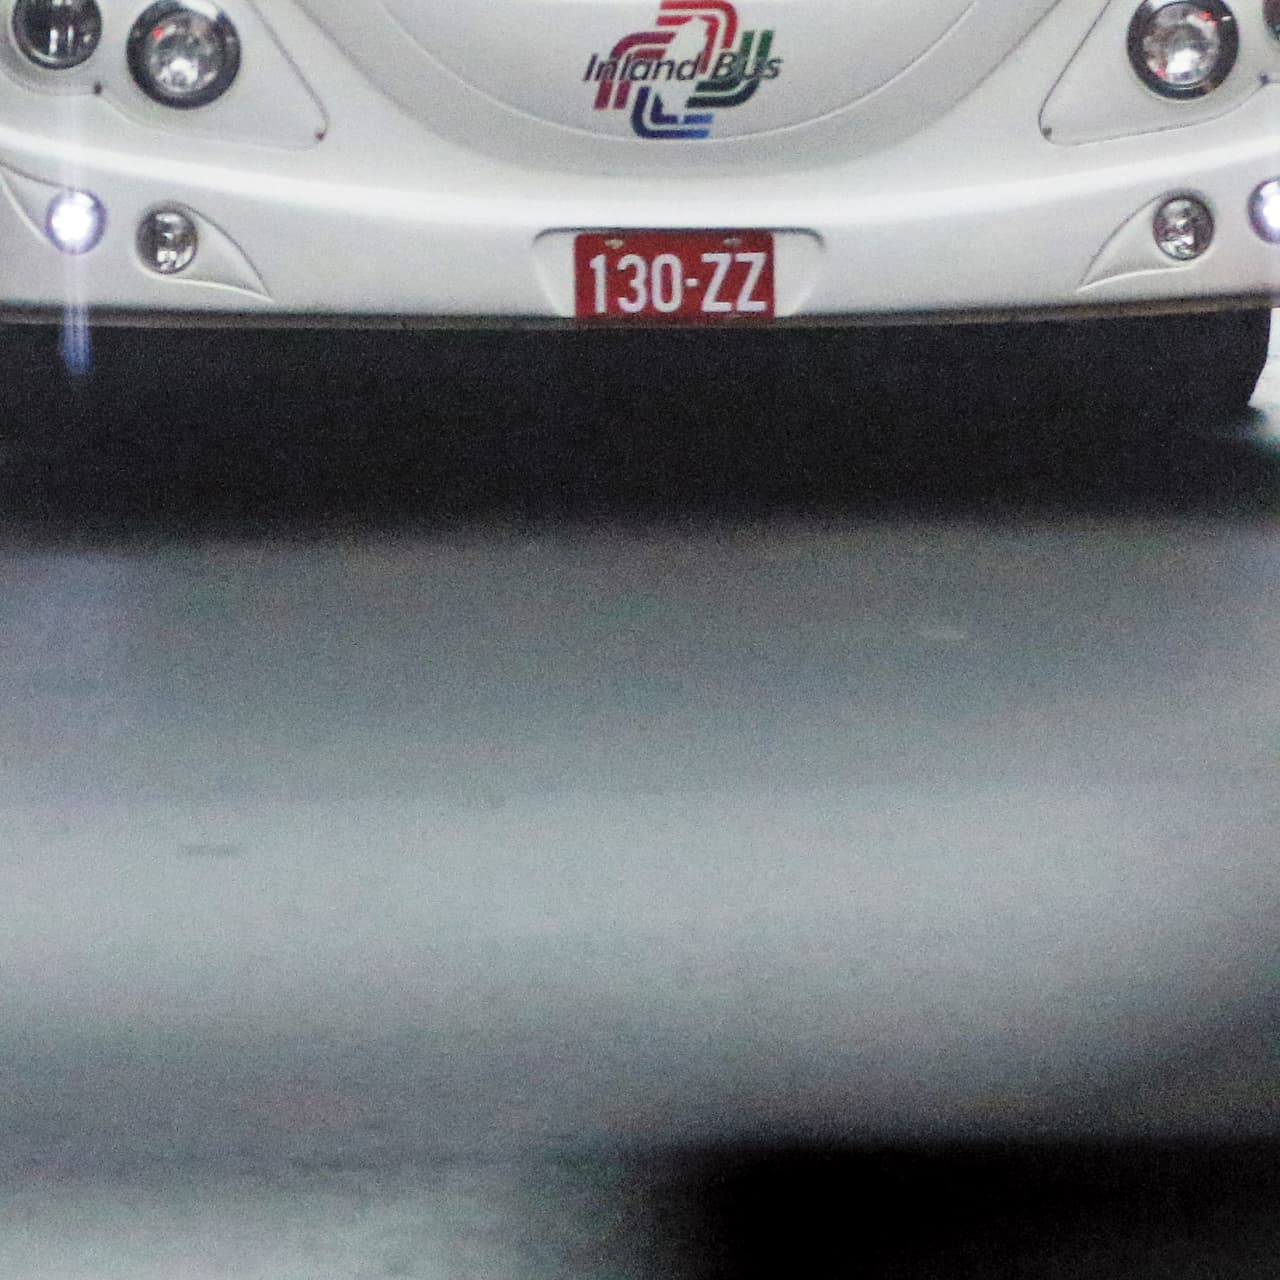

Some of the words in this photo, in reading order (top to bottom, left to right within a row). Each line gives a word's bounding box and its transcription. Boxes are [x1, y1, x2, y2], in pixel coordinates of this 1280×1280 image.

[583, 53, 698, 83] Inland
[712, 51, 784, 81] Bus
[589, 252, 767, 313] 130-ZZ
